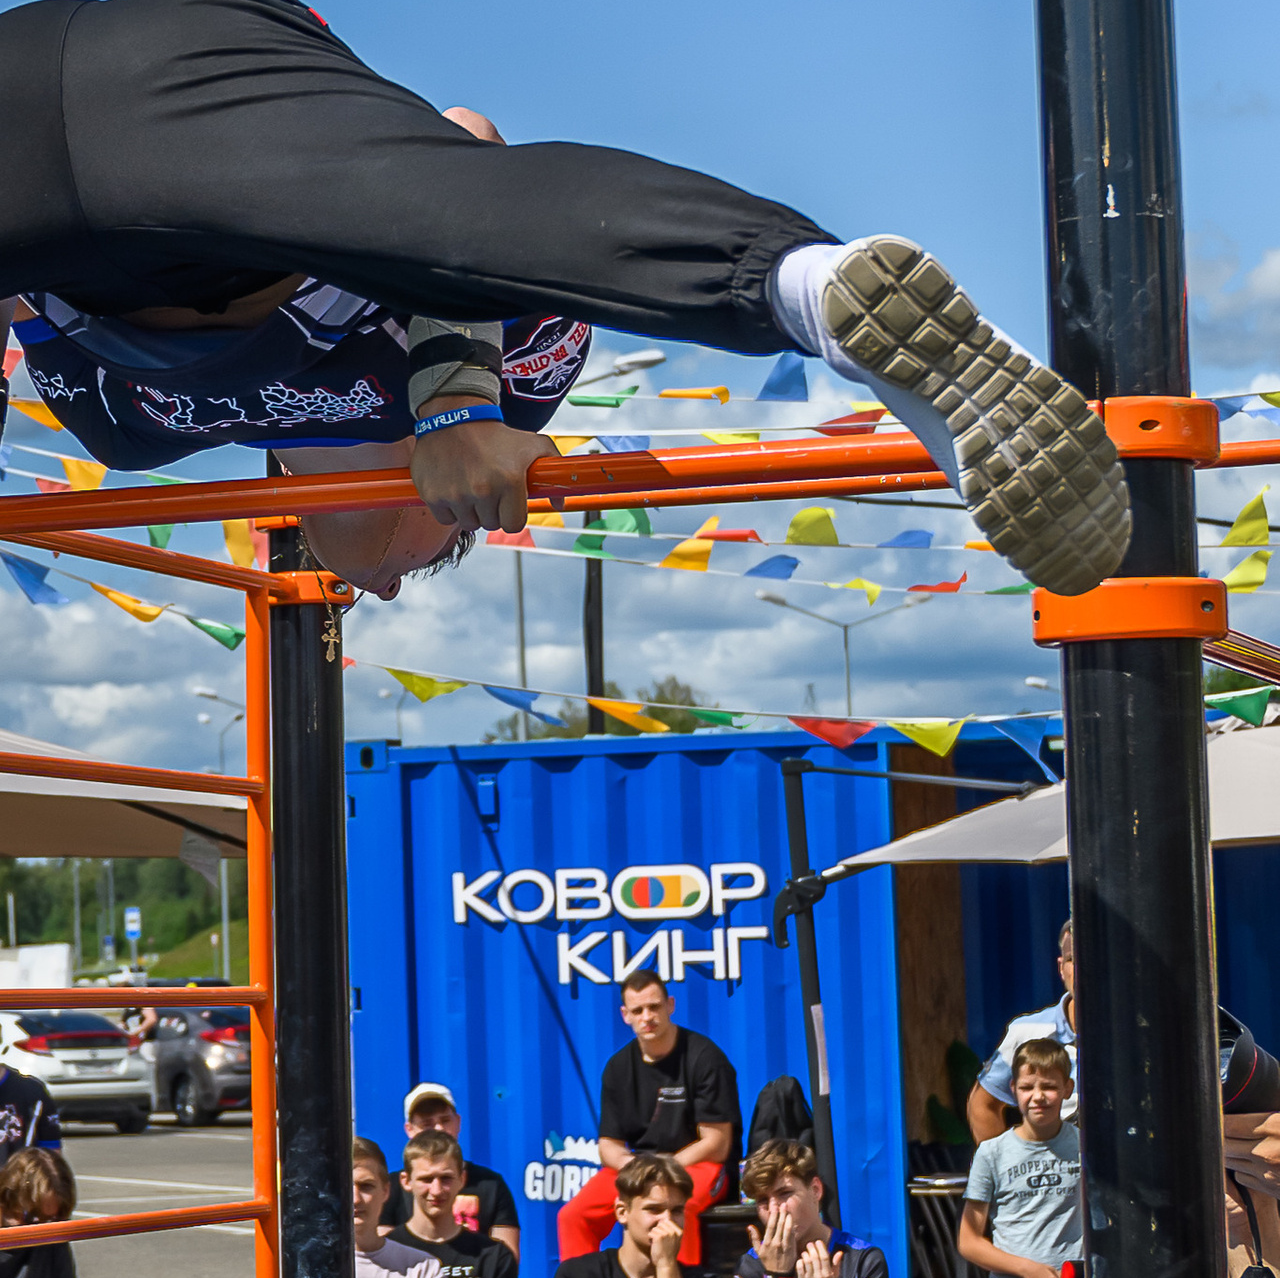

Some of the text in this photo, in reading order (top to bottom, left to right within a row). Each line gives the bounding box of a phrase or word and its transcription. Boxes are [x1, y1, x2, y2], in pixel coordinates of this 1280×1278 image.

[433, 409, 471, 428] БИТВА
[557, 925, 770, 985] КИНГ
[524, 1161, 599, 1202] GOR
[1007, 1158, 1063, 1184] PROPERTY
[1029, 1174, 1059, 1187] GAP
[440, 1265, 474, 1277] EET
